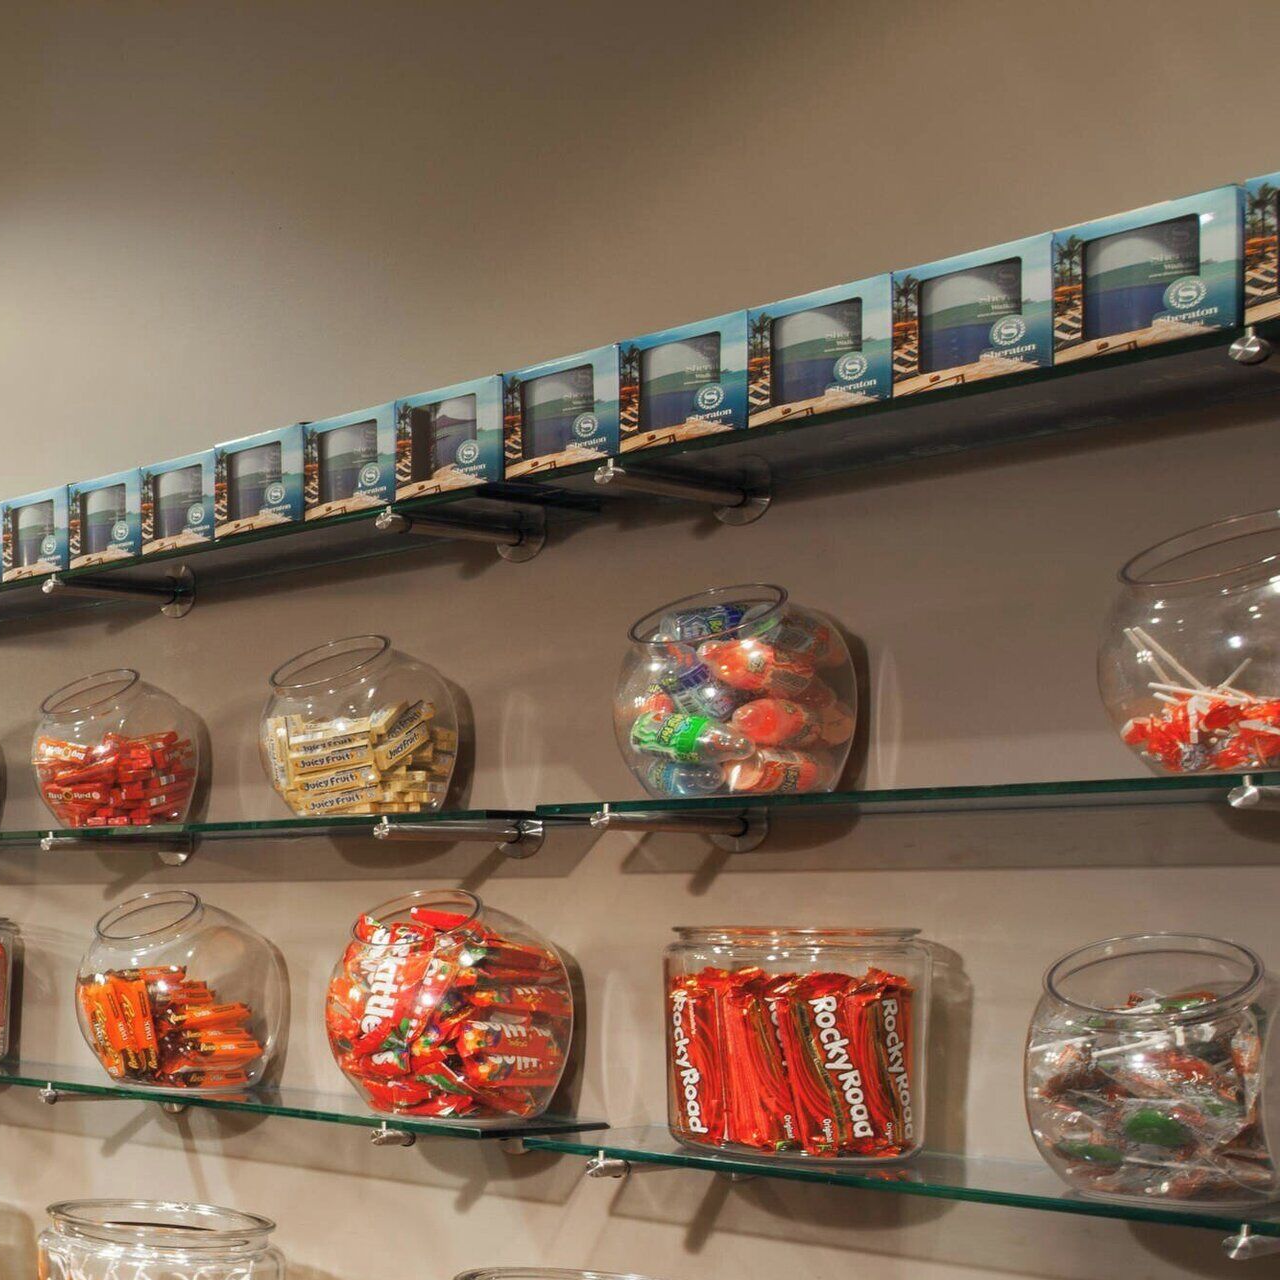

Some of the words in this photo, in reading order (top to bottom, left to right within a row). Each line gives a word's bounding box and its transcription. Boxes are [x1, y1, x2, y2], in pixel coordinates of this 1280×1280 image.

[300, 757, 325, 769] Juicy
[326, 752, 350, 764] Fruit
[304, 780, 329, 791] Juicy
[330, 774, 355, 787] Fruit
[310, 799, 334, 811] Juicy
[335, 794, 361, 806] Fruit
[808, 995, 853, 1071] Rocky
[839, 1070, 875, 1139] Road
